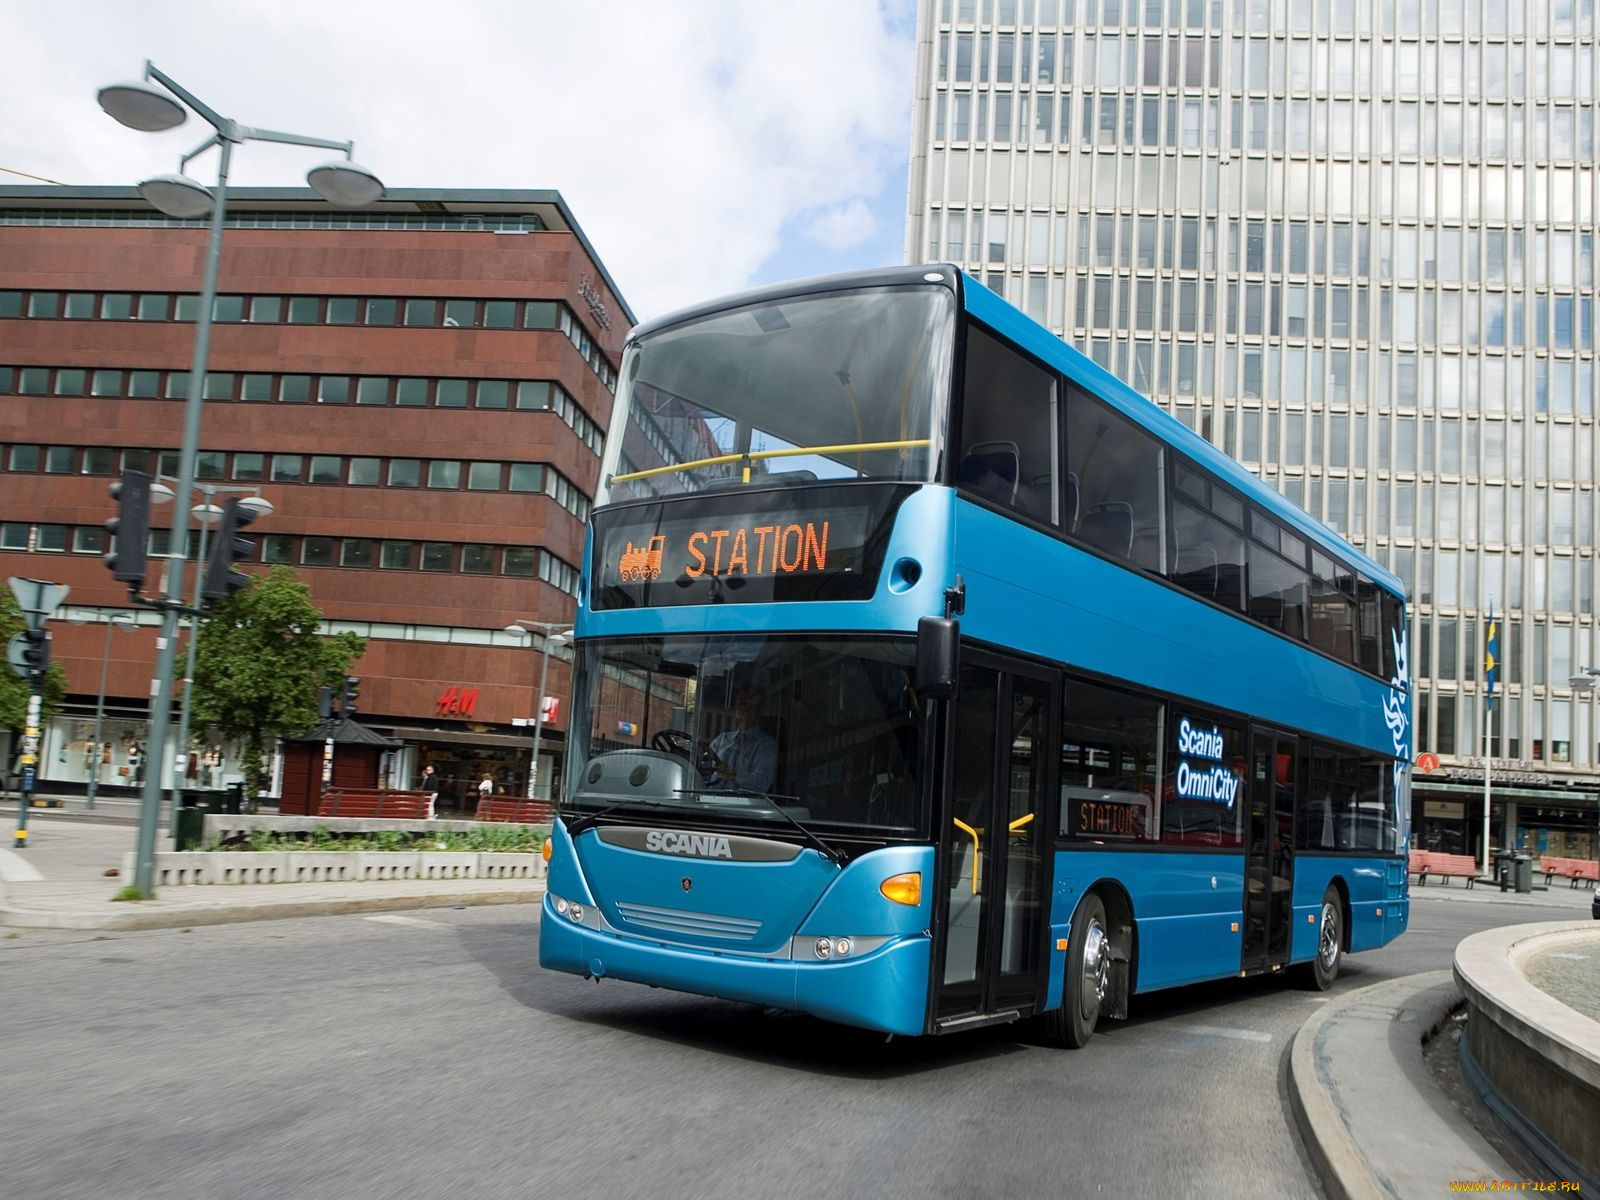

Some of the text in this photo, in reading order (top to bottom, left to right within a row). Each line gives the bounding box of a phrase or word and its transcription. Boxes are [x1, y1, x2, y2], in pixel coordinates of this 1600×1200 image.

[686, 521, 829, 578] STATION
[1179, 719, 1223, 760] Scania
[1177, 762, 1238, 809] OmniCity
[1080, 803, 1133, 833] STATION
[645, 831, 732, 858] SCANIA
